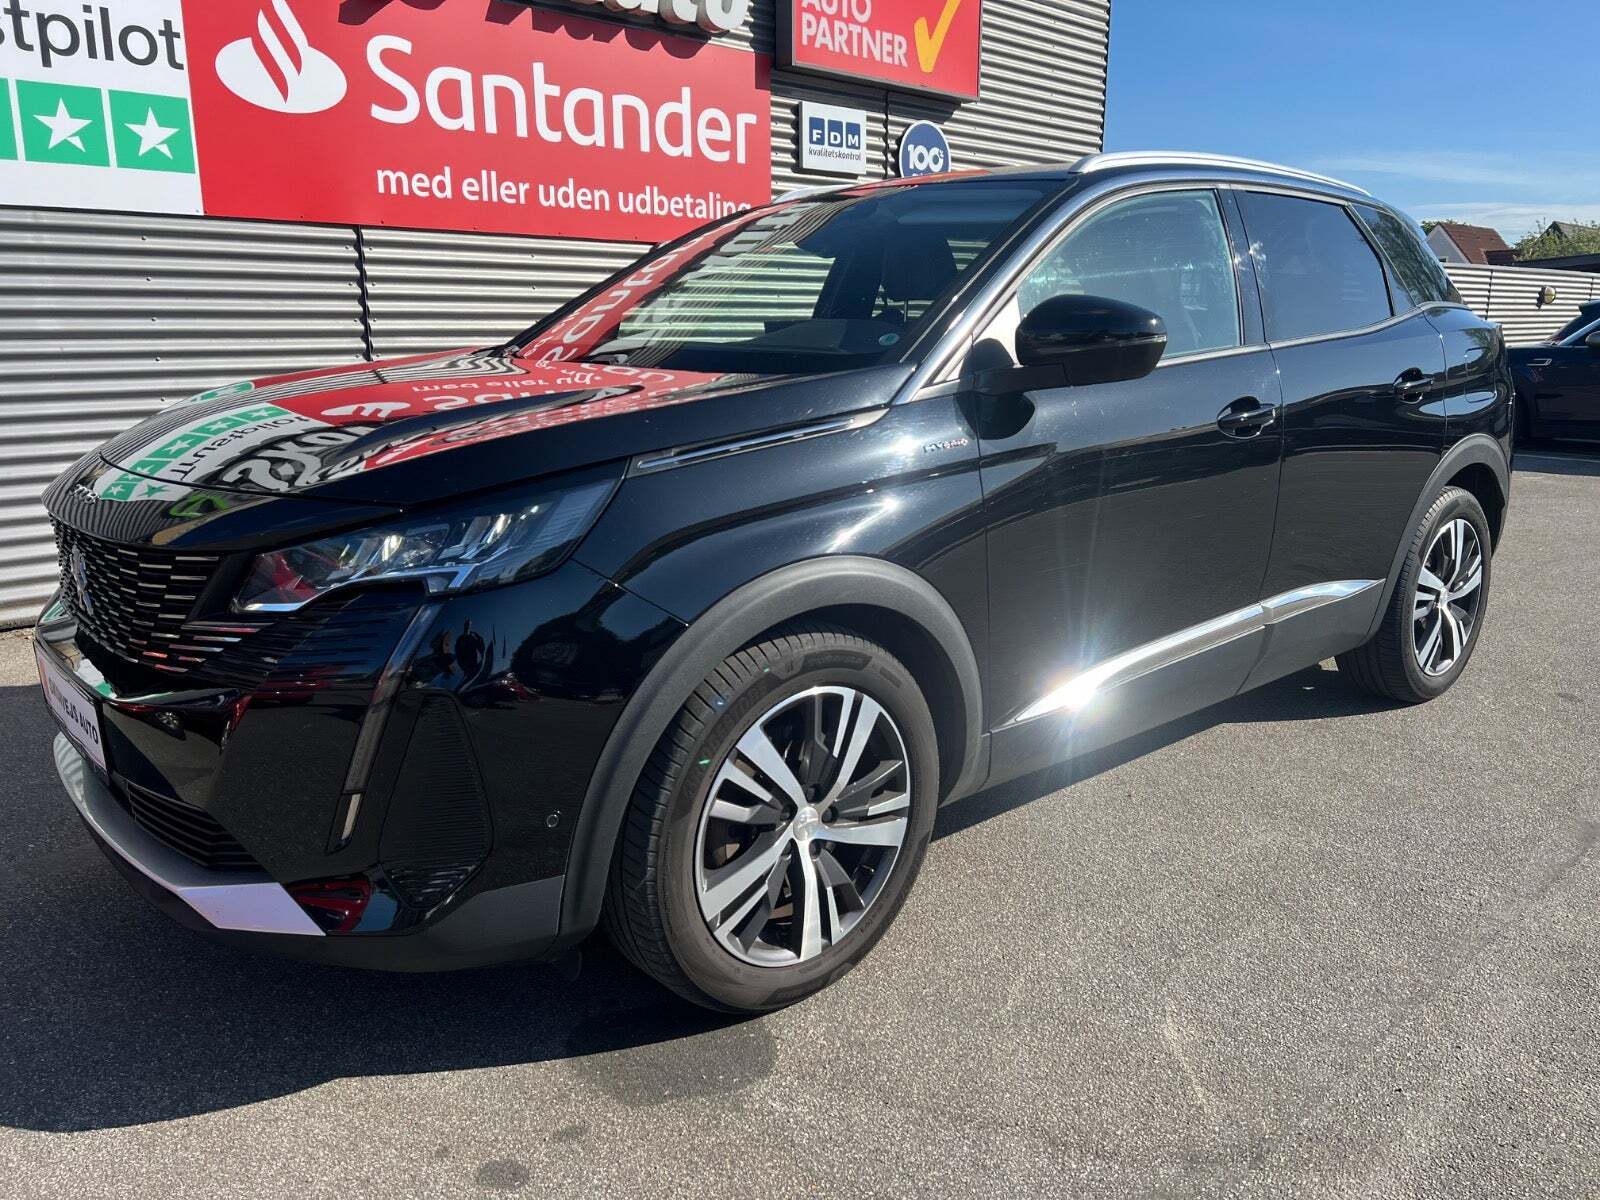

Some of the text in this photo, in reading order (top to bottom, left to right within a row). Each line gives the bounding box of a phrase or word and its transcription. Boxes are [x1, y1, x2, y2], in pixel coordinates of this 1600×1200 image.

[0, 0, 184, 70] tpilot
[801, 12, 908, 68] PARTNER
[366, 34, 757, 164] Santander
[808, 148, 862, 162] kvalitetskontrol
[812, 129, 859, 147] FDM
[377, 166, 452, 199] med
[461, 170, 530, 205] eller
[539, 177, 610, 211] uden
